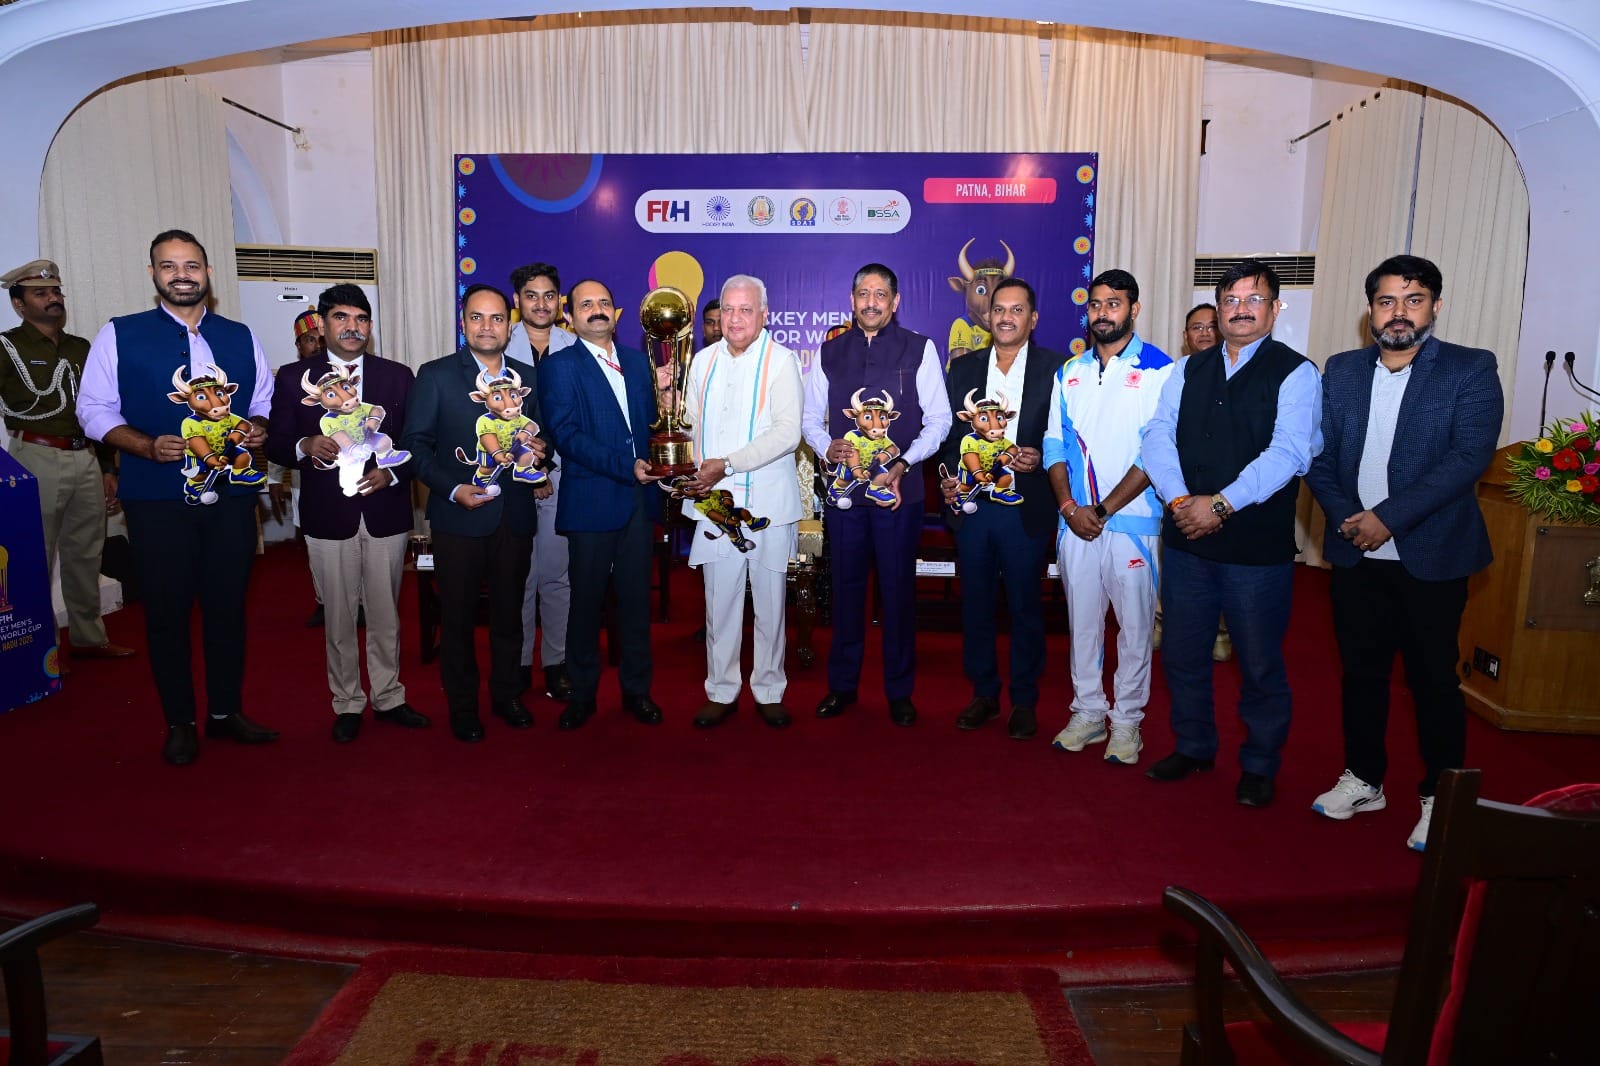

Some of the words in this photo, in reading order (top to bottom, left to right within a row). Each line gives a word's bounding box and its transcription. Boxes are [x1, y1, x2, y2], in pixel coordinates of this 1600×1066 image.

[956, 183, 992, 199] PATNA,
[995, 183, 1026, 197] BIHAR
[867, 209, 900, 218] BSSA
[28, 623, 42, 633] CUP
